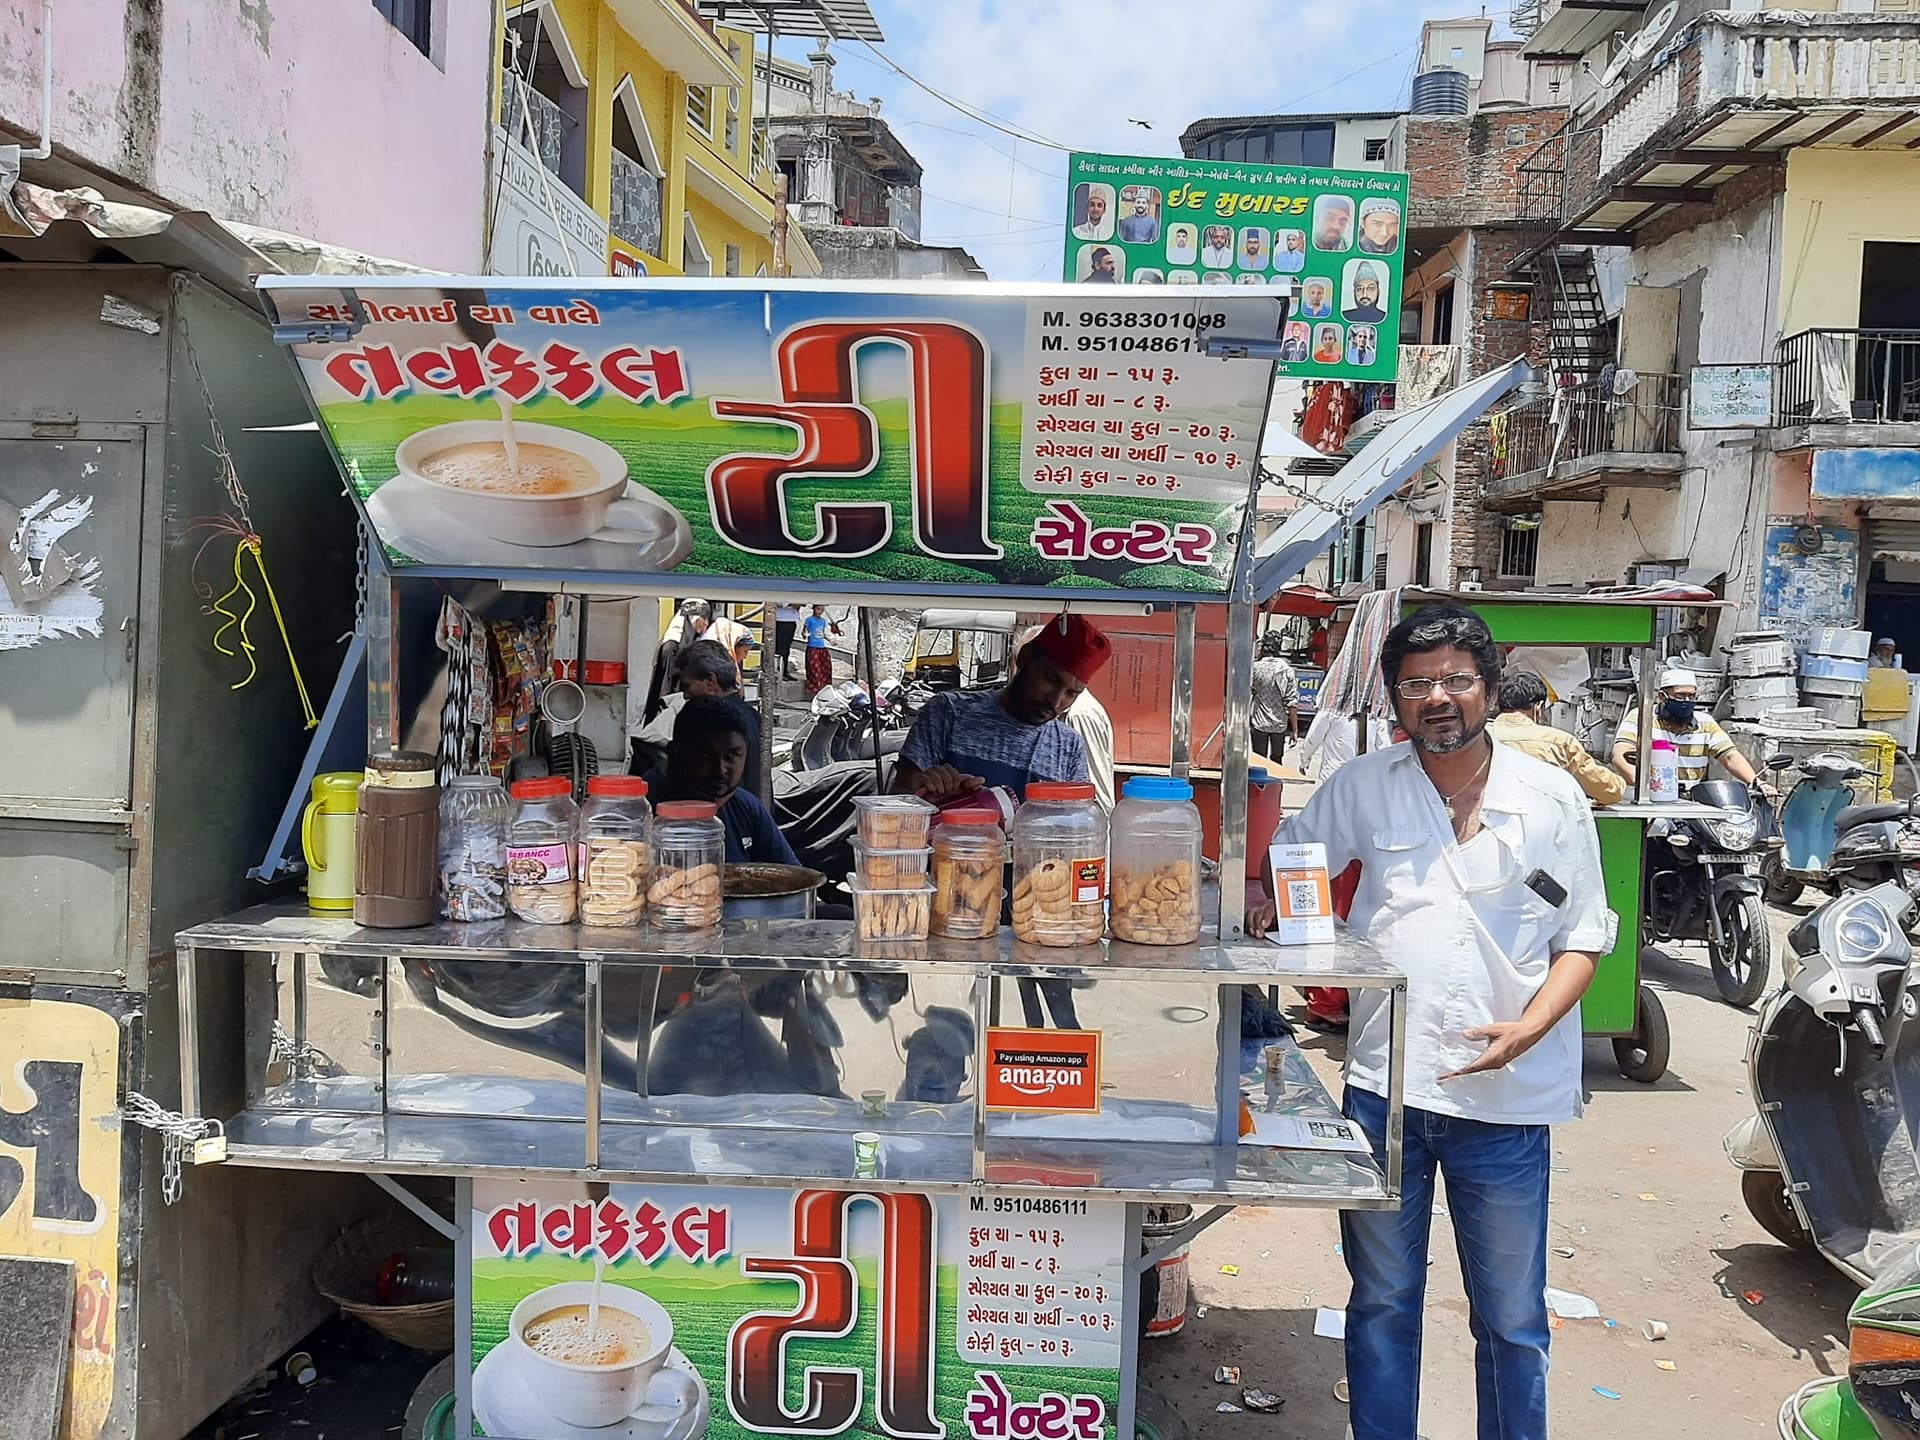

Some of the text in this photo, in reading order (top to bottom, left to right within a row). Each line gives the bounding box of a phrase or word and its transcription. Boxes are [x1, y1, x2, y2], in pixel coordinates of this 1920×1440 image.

[1167, 183, 1310, 217] ઈદ મુબારક
[575, 213, 605, 257] STORE
[470, 304, 516, 326] ચા
[528, 299, 601, 327] વાલે
[1043, 311, 1227, 330] M. 9638301098
[1041, 335, 1069, 351] M.
[1077, 367, 1098, 381] ચા
[1127, 367, 1154, 382] ૧૫
[1162, 368, 1180, 386] રૂ.
[1085, 394, 1105, 408] ચા
[1133, 395, 1145, 409] ૮
[1153, 395, 1171, 412] રૂ.
[705, 317, 1004, 559] ટી
[1103, 420, 1123, 434] ચા
[1187, 424, 1211, 438] ૨૦
[1218, 426, 1236, 443] રૂ.
[1100, 445, 1120, 460] ચા
[1193, 450, 1217, 465] ૧૦
[1225, 453, 1242, 470] રૂ.
[1033, 465, 1073, 485] કોફી
[1135, 473, 1157, 487] ૨૦
[1164, 475, 1182, 491] રૂ.
[1034, 503, 1214, 564] સેન્ટર
[1000, 1053, 1082, 1065] Pay using Amazon app
[999, 1067, 1083, 1086] amazon
[970, 1196, 1088, 1214] M. 9510486111
[995, 1228, 1009, 1243] ચા
[1028, 1229, 1047, 1244] ૧૫
[1052, 1230, 1065, 1247] રૂ.
[1001, 1256, 1015, 1270] ચા
[1034, 1257, 1042, 1271] ૮
[1048, 1257, 1060, 1274] રૂ.
[1014, 1284, 1028, 1298] ચા
[1074, 1286, 1090, 1300] ૨૦
[1095, 1286, 1108, 1304] રૂ.
[726, 1189, 946, 1439] ટી
[1014, 1311, 1028, 1325] ચા
[1080, 1314, 1097, 1327] ૧૦
[1102, 1314, 1115, 1331] રૂ.
[966, 1331, 994, 1353] કોફી
[1040, 1339, 1056, 1353] ૨૦
[1062, 1340, 1074, 1357] રૂ.
[967, 1373, 1103, 1440] સેન્ટર
